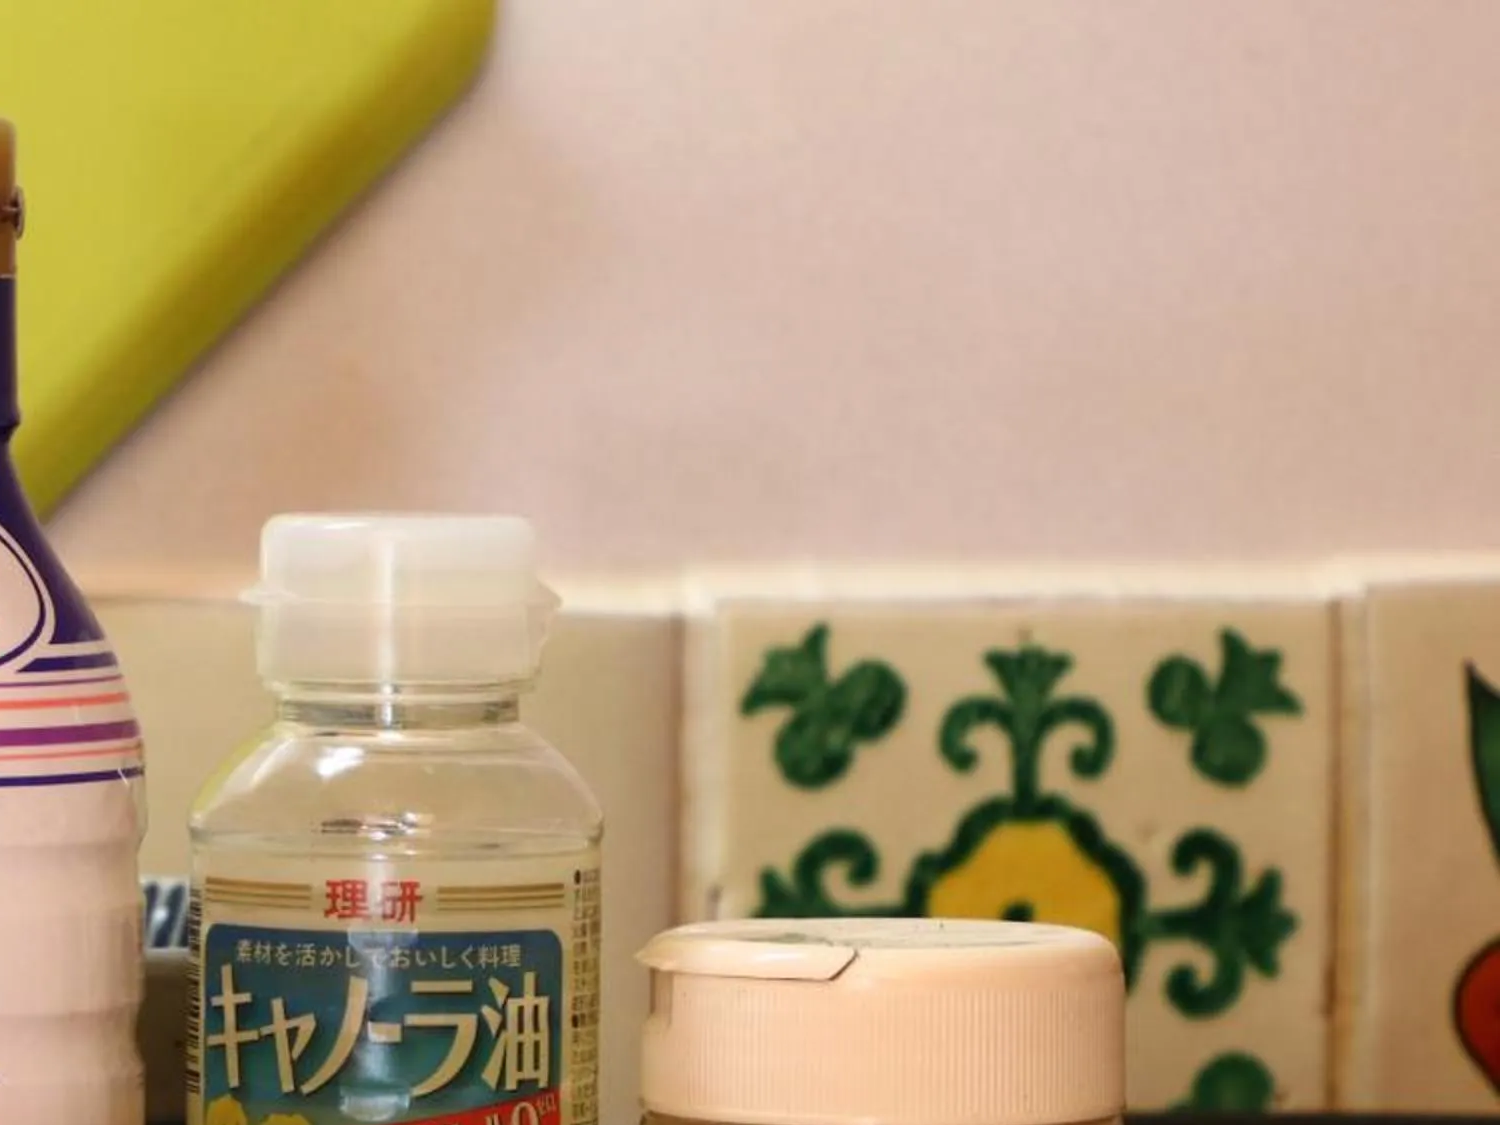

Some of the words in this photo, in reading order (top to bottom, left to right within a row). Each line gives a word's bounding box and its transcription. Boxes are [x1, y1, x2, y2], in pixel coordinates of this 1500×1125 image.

[324, 879, 423, 923] 理研
[206, 964, 551, 1096] キャノーラ油
